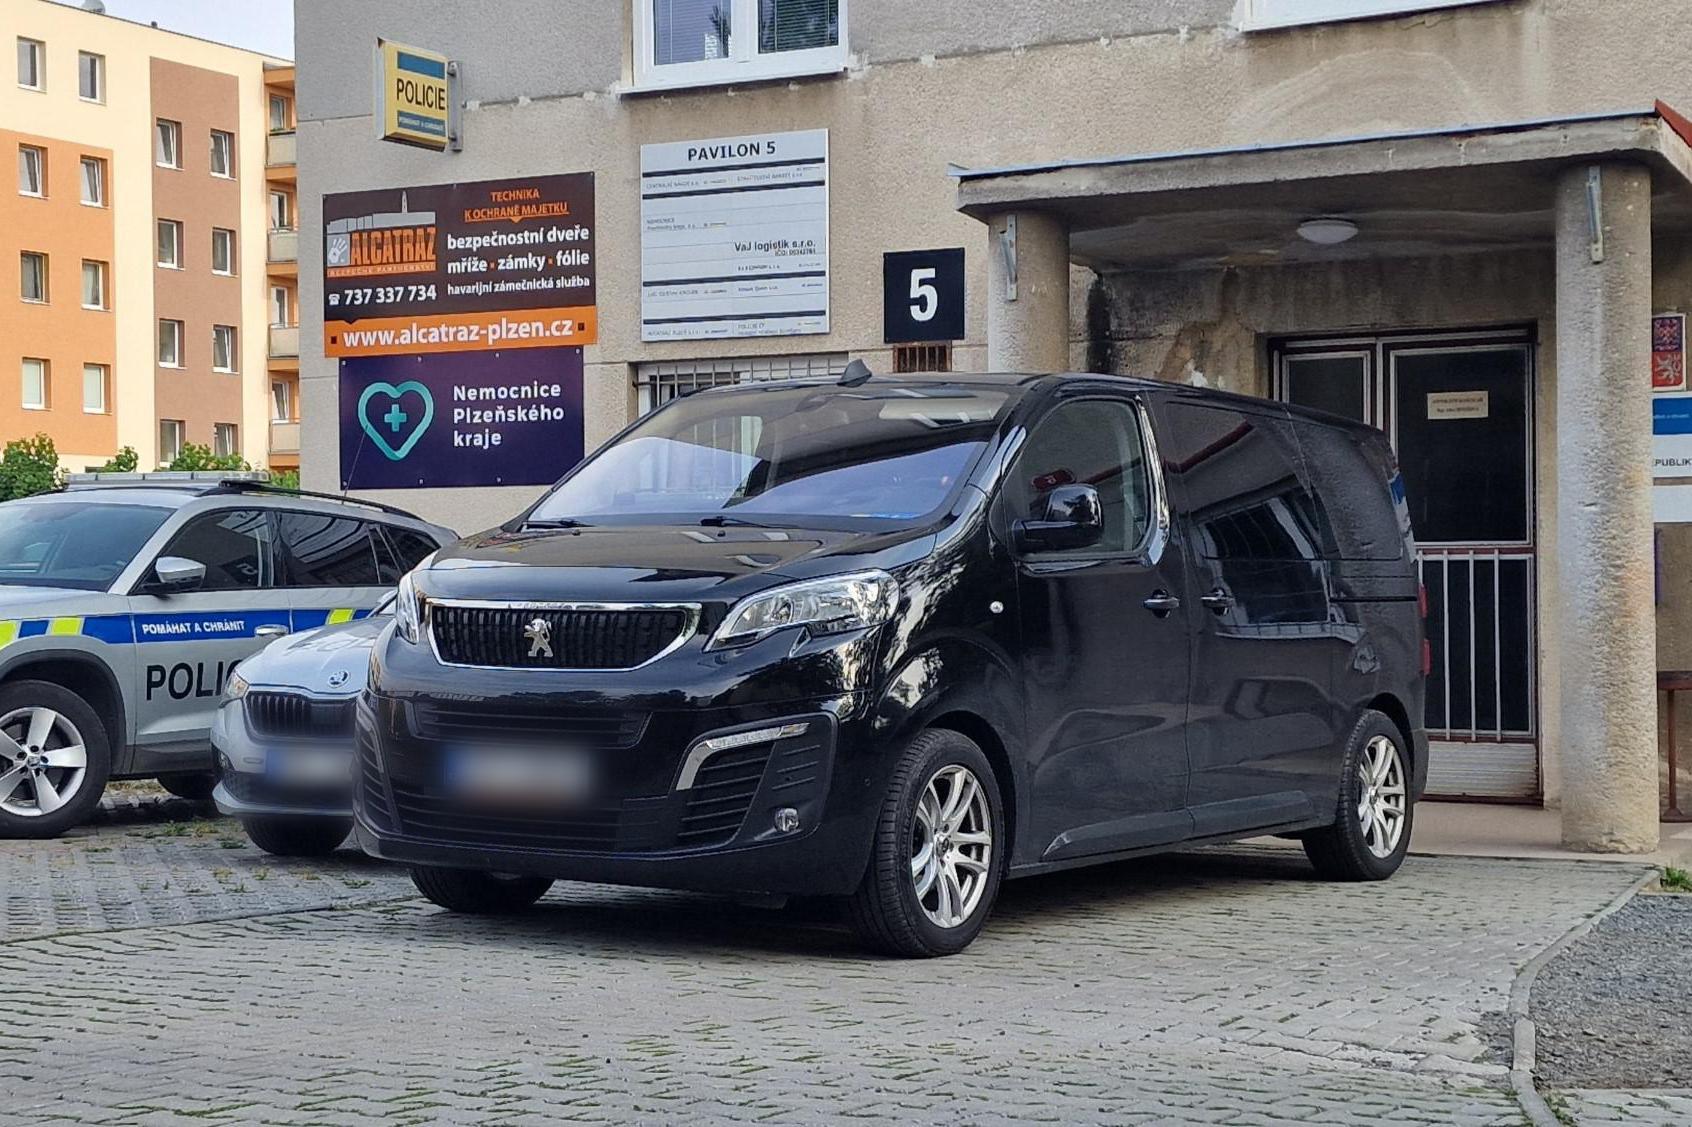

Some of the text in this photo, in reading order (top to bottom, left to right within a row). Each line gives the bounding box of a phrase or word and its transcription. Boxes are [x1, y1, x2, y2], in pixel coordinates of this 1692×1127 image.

[396, 77, 446, 110] POLICIE
[688, 141, 777, 162] PAVILON 5
[490, 188, 540, 202] TECHNIKA
[464, 202, 569, 221] K OCHRANĚ MAJETKU
[350, 226, 437, 266] ALCATRAZ
[447, 224, 590, 252] bezpečnostní dveře
[734, 242, 752, 252] VaJ
[754, 240, 790, 252] logistik
[447, 257, 488, 274] mříže
[497, 252, 546, 272] zámky
[556, 249, 590, 267] fólie
[344, 284, 437, 305] 737 337 734
[447, 275, 590, 296] havarijní zámečnická služba
[910, 267, 938, 322] 5
[343, 317, 574, 348] www.alcatraz-plzen.cz
[453, 380, 562, 401] Nemocnice
[453, 404, 565, 424] Plzeňského
[453, 428, 502, 449] kraje
[1654, 458, 1692, 468] PUBLIK
[142, 619, 245, 635] POMÁHAT A CHRÁNIT
[146, 660, 243, 701] POLI
